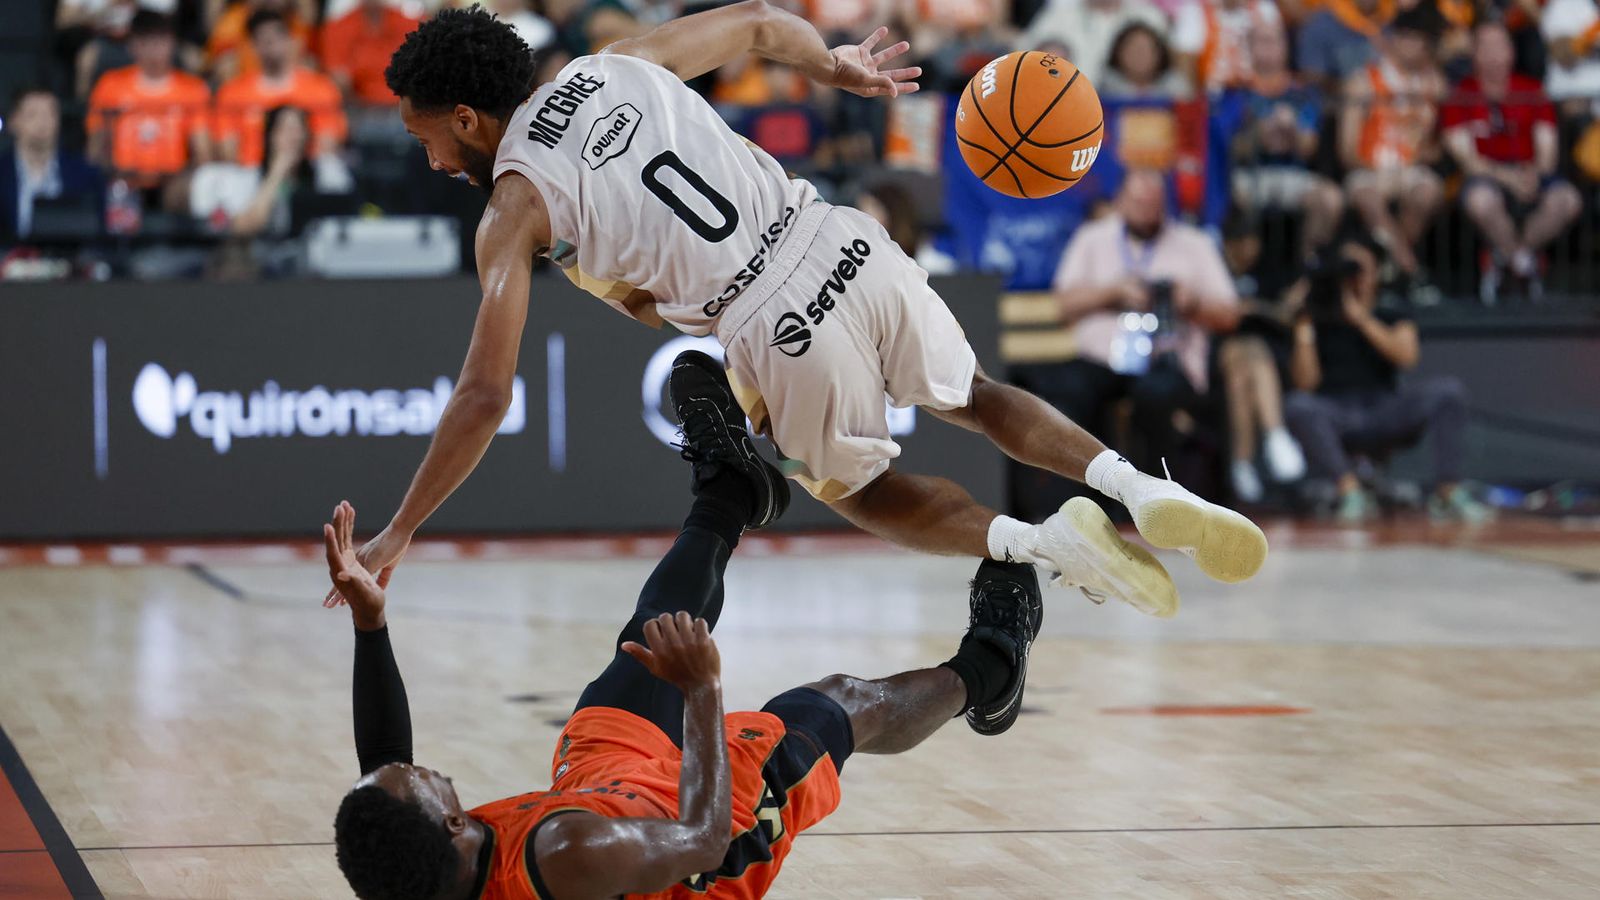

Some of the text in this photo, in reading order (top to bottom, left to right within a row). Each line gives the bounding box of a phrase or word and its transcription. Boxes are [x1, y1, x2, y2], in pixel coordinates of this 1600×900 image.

[527, 72, 606, 150] MCGHEE
[591, 112, 631, 158] ownat
[640, 150, 740, 243] 0
[806, 238, 871, 326] serveto
[190, 375, 526, 454] quirónsal
